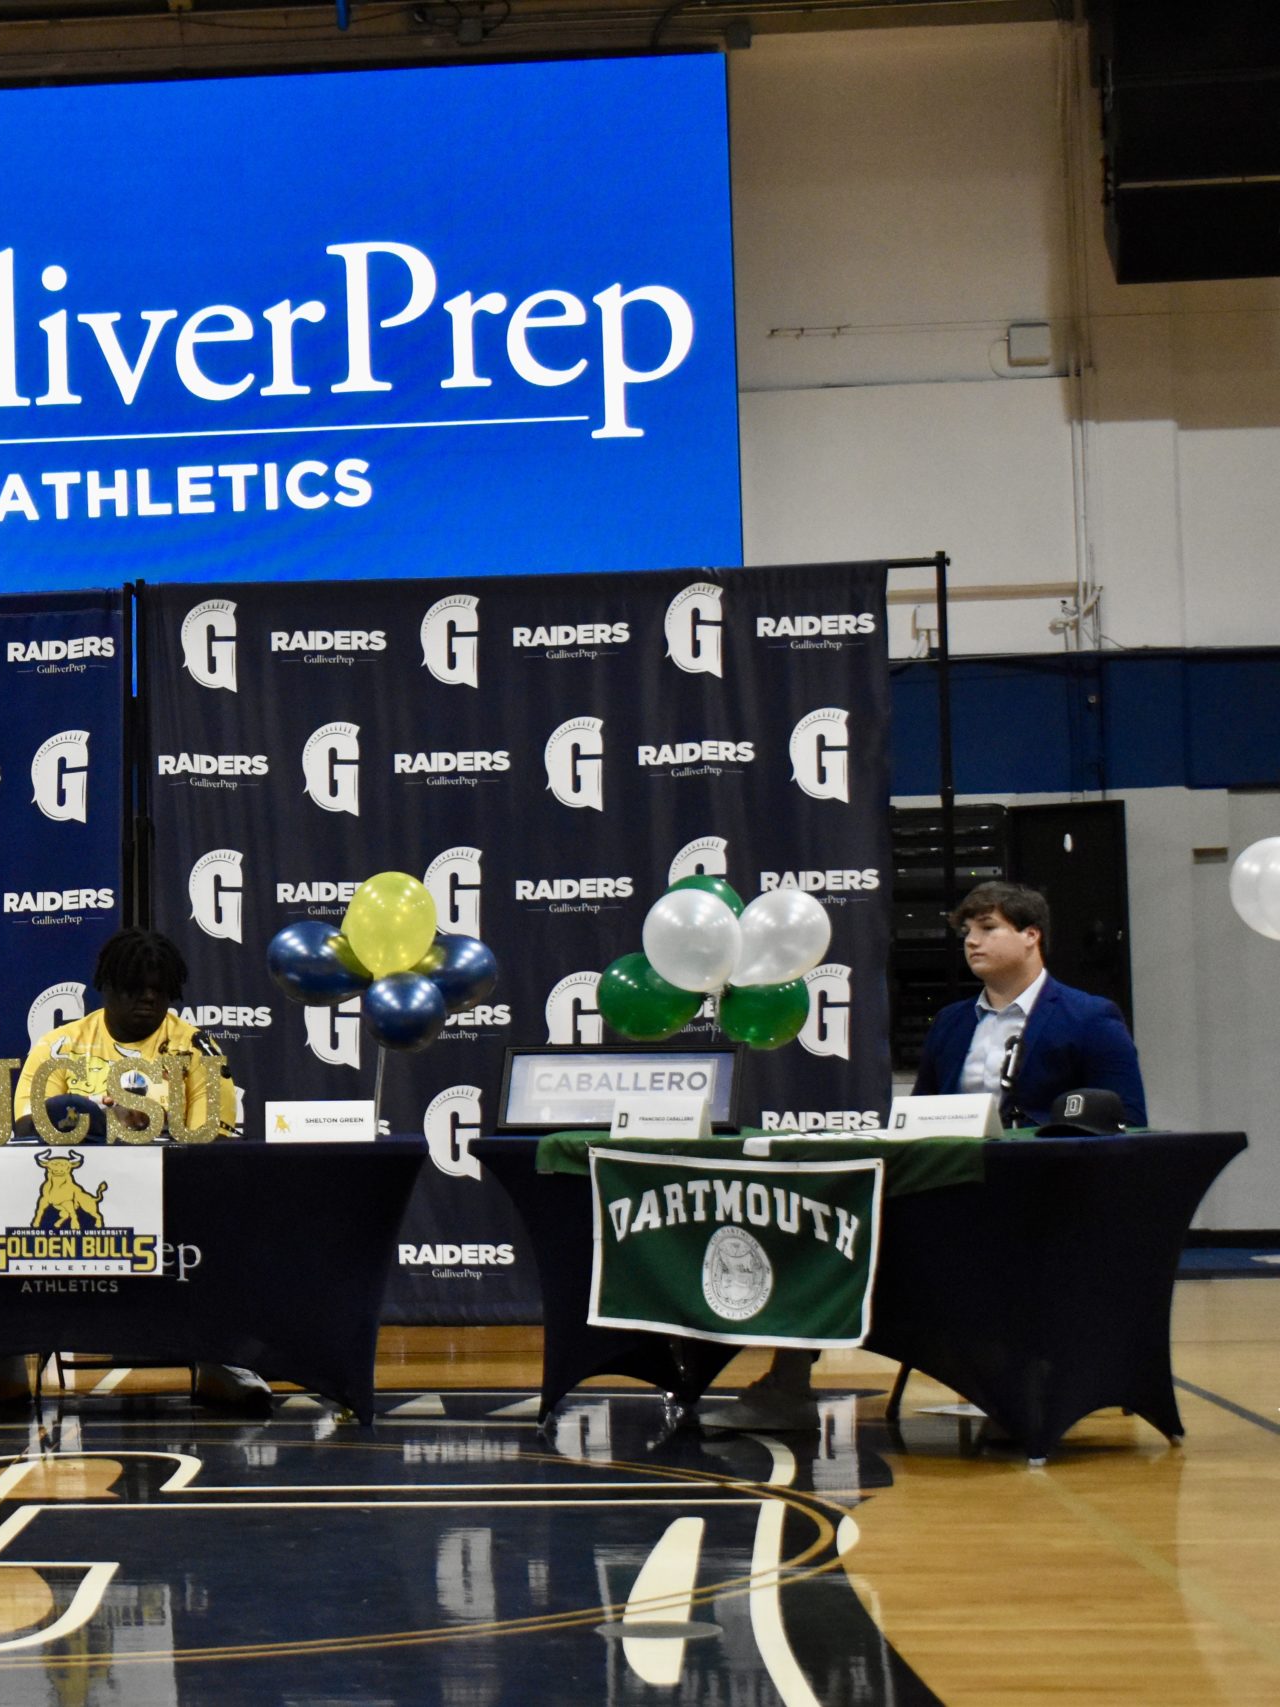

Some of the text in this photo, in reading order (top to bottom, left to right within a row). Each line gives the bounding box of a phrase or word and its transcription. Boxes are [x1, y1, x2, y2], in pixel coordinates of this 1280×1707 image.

[513, 623, 630, 647] RAIDERS
[757, 613, 875, 637] RAIDERS
[8, 637, 114, 662] RAIDERS
[271, 631, 386, 651] RAIDERS
[790, 640, 842, 650] GulliverPrep
[304, 655, 354, 666] GulliverPrep
[546, 649, 598, 659] GulliverPrep
[37, 664, 86, 673] GulliverPrep
[395, 751, 510, 773] RAIDERS
[638, 741, 755, 765] RAIDERS
[158, 753, 268, 775] RAIDERS
[671, 765, 722, 777] GulliverPrep
[190, 778, 237, 790] GulliverPrep
[427, 776, 478, 787] GulliverPrep
[516, 877, 633, 900] RAIDERS
[4, 888, 114, 912] RAIDERS
[549, 903, 600, 914] GulliverPrep
[32, 915, 82, 924] GulliverPrep
[536, 1071, 708, 1092] CABALLERO
[1064, 1094, 1084, 1116] D
[762, 1111, 882, 1132] RAIDERS
[608, 1179, 860, 1261] DARTMOUTH
[82, 1236, 158, 1271] BULLS
[399, 1244, 514, 1264] RAIDERS
[432, 1269, 482, 1280] GulliverPrep
[21, 1280, 119, 1293] ATHLETICS
